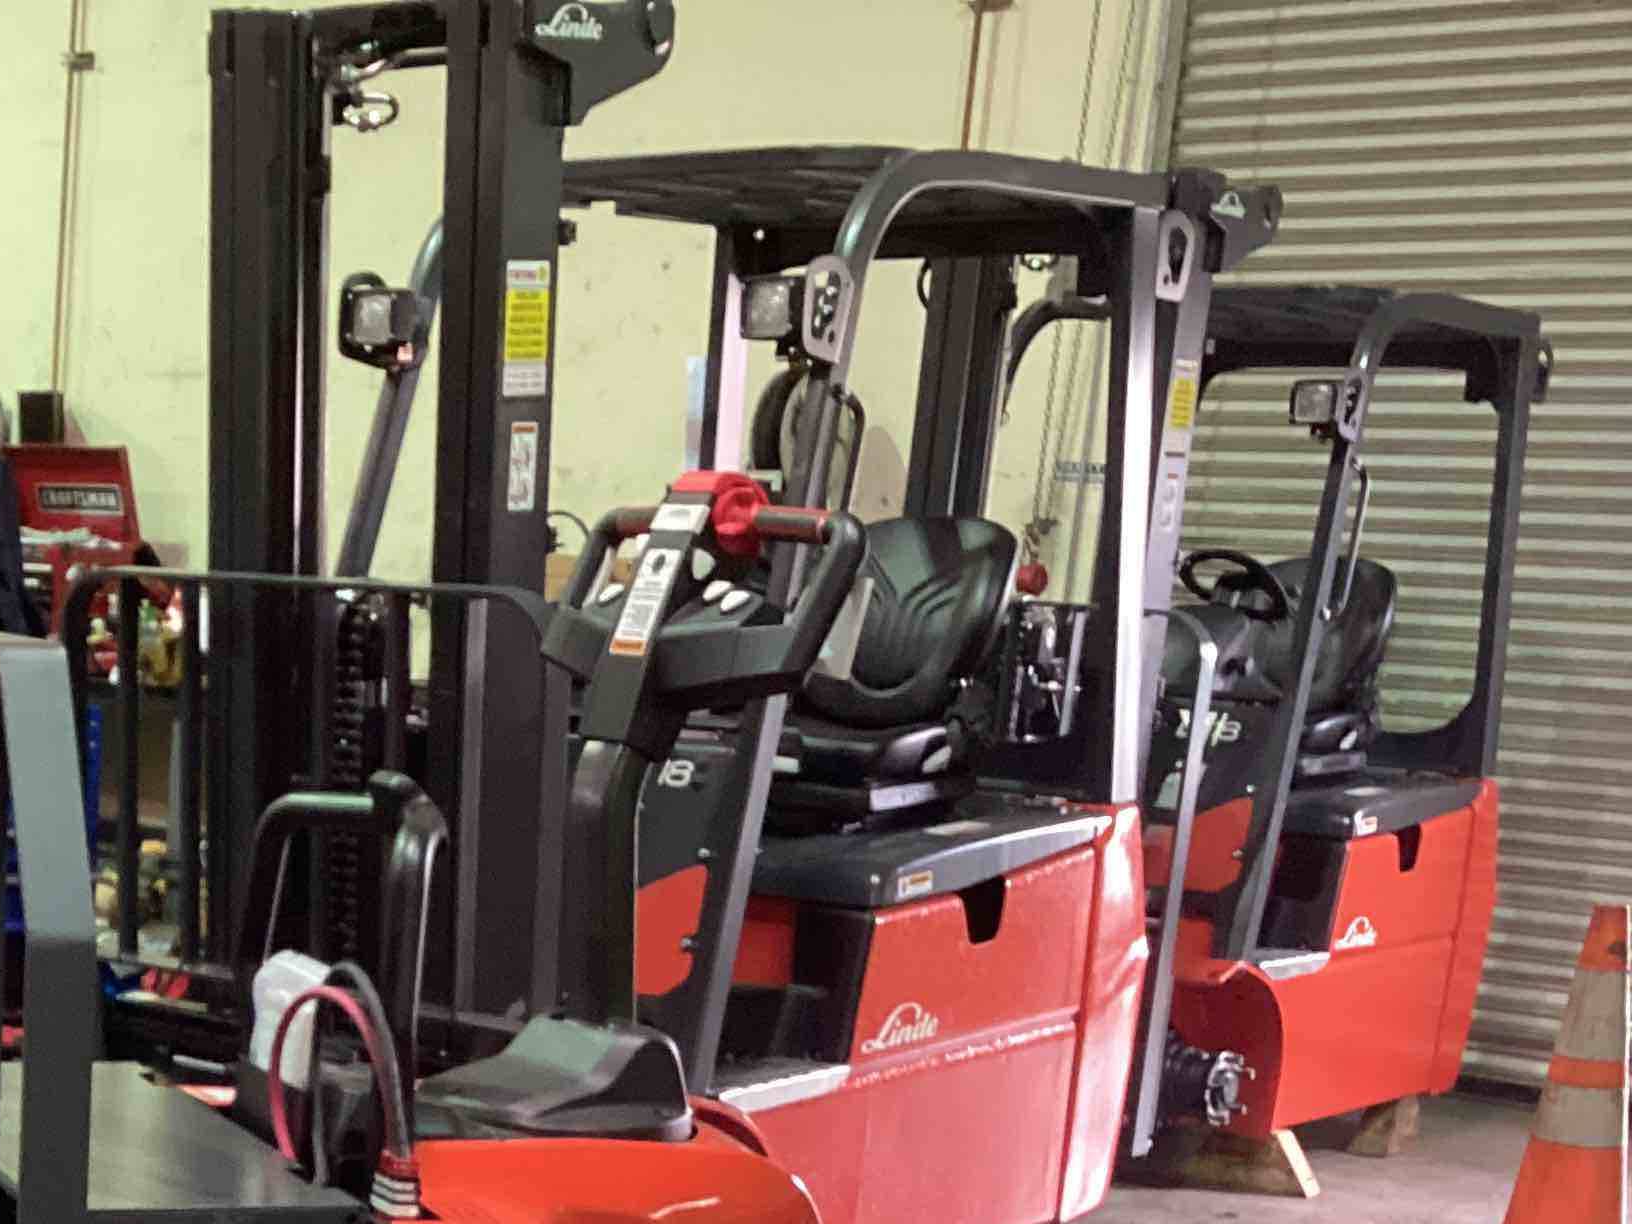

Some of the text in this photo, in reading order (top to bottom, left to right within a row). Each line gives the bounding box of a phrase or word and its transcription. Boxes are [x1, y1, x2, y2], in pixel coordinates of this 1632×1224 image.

[534, 3, 603, 40] Linde
[41, 489, 118, 507] CRAFTSMAN
[861, 1002, 939, 1053] Linde
